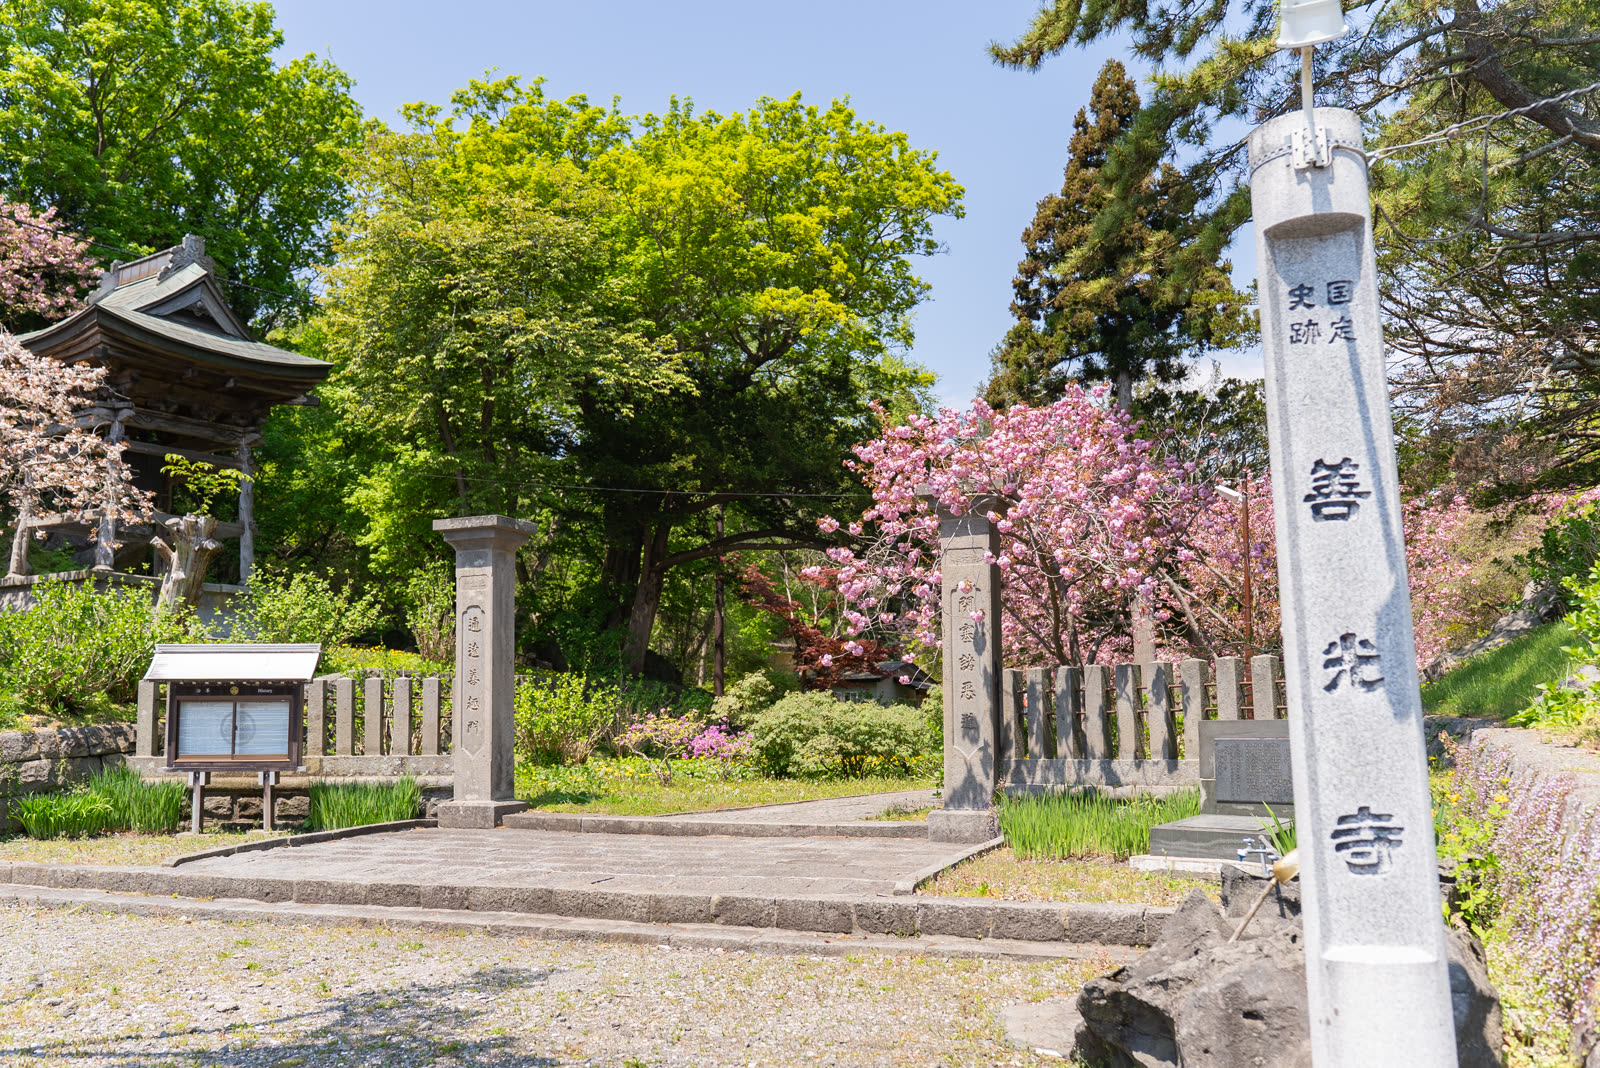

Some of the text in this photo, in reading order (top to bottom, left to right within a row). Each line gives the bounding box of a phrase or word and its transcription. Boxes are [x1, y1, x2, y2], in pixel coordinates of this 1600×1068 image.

[1288, 282, 1322, 346] 史跡
[1327, 280, 1357, 344] 国定
[1303, 457, 1404, 876] 善光寺
